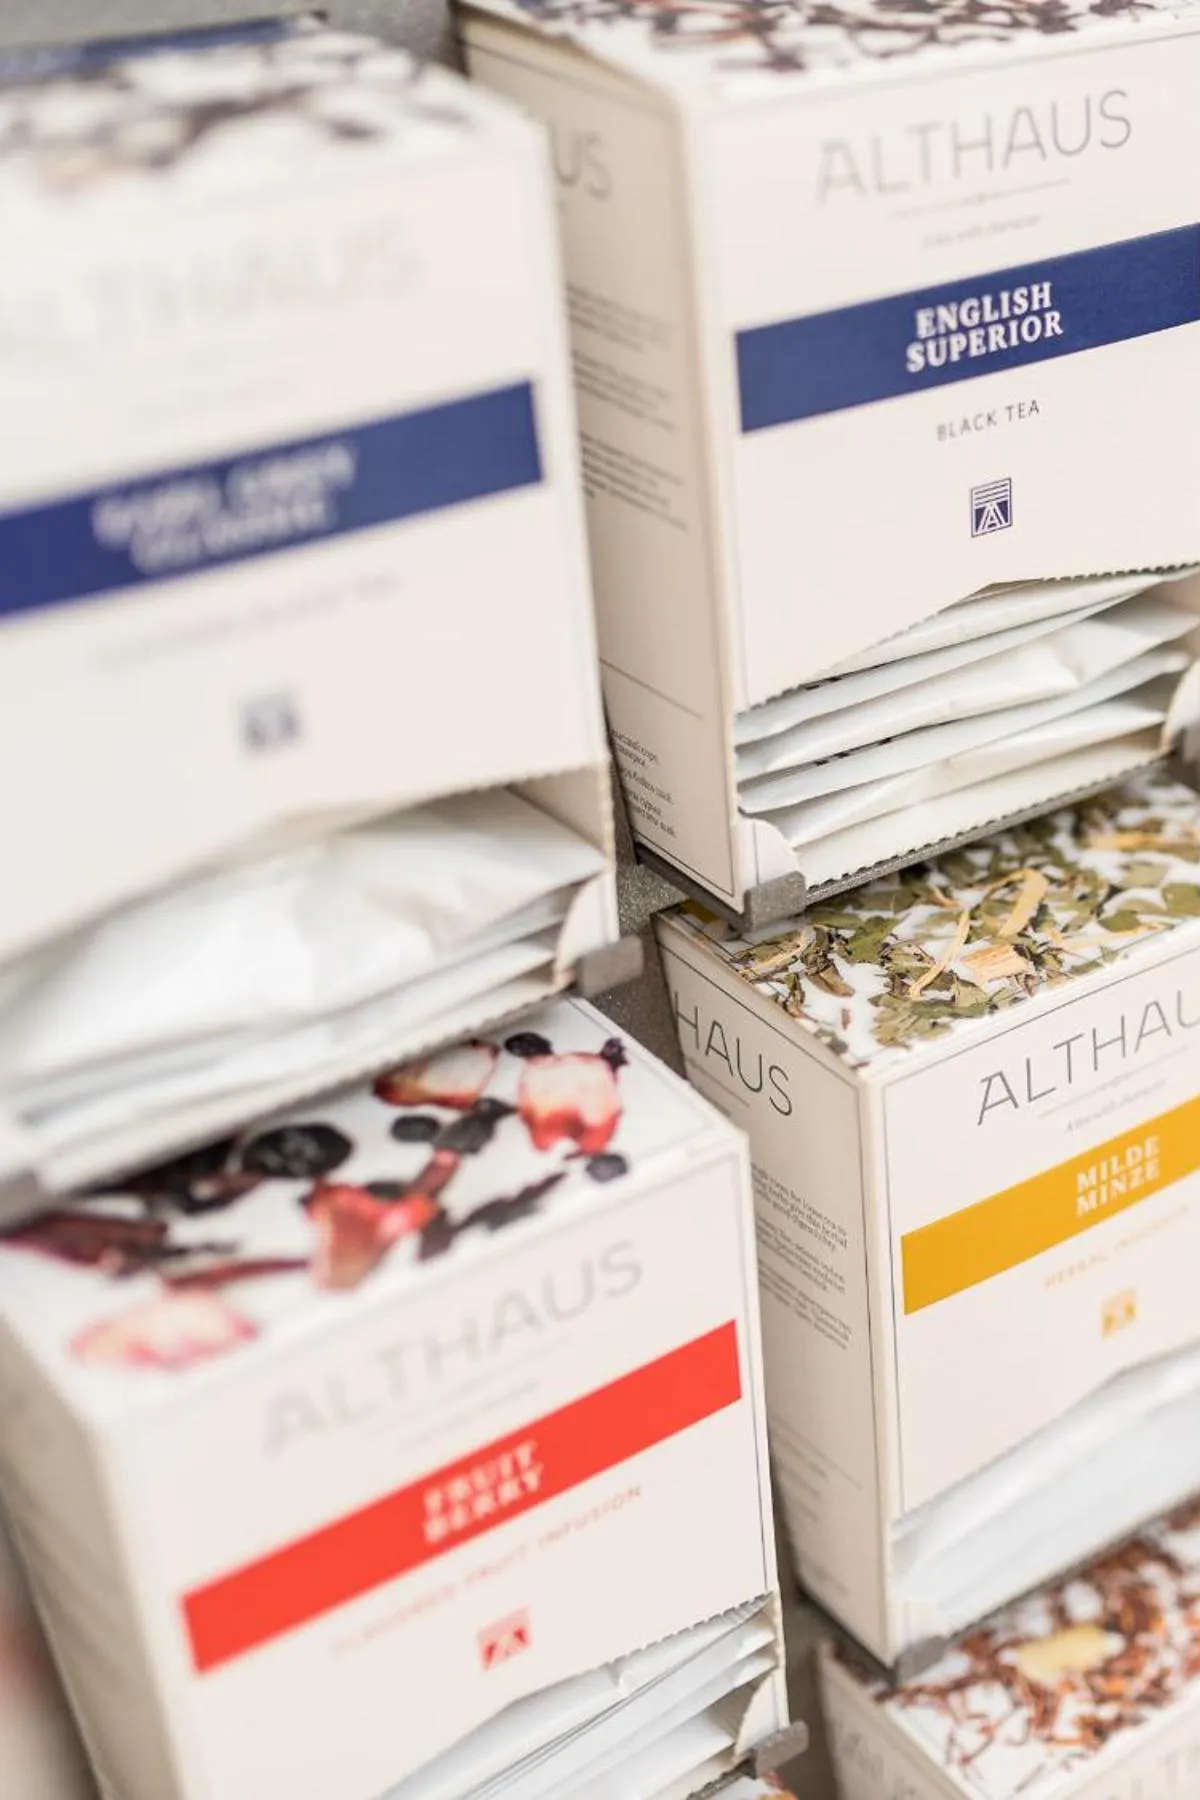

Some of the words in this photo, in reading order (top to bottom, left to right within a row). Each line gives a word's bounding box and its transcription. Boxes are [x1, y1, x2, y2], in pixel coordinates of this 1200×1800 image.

[815, 88, 1132, 204] ALTHAUS
[906, 311, 1064, 373] SUPERIOR
[915, 281, 1052, 339] ENGLISH
[937, 410, 998, 442] BLACK
[1006, 399, 1041, 423] TEA
[674, 989, 793, 1117] HAUS
[1076, 1135, 1160, 1193] MILDE
[1076, 1157, 1160, 1217] MINZE
[264, 1240, 644, 1460] ALTHAUS
[423, 1440, 538, 1512] FRUIT
[423, 1462, 543, 1545] BERRY
